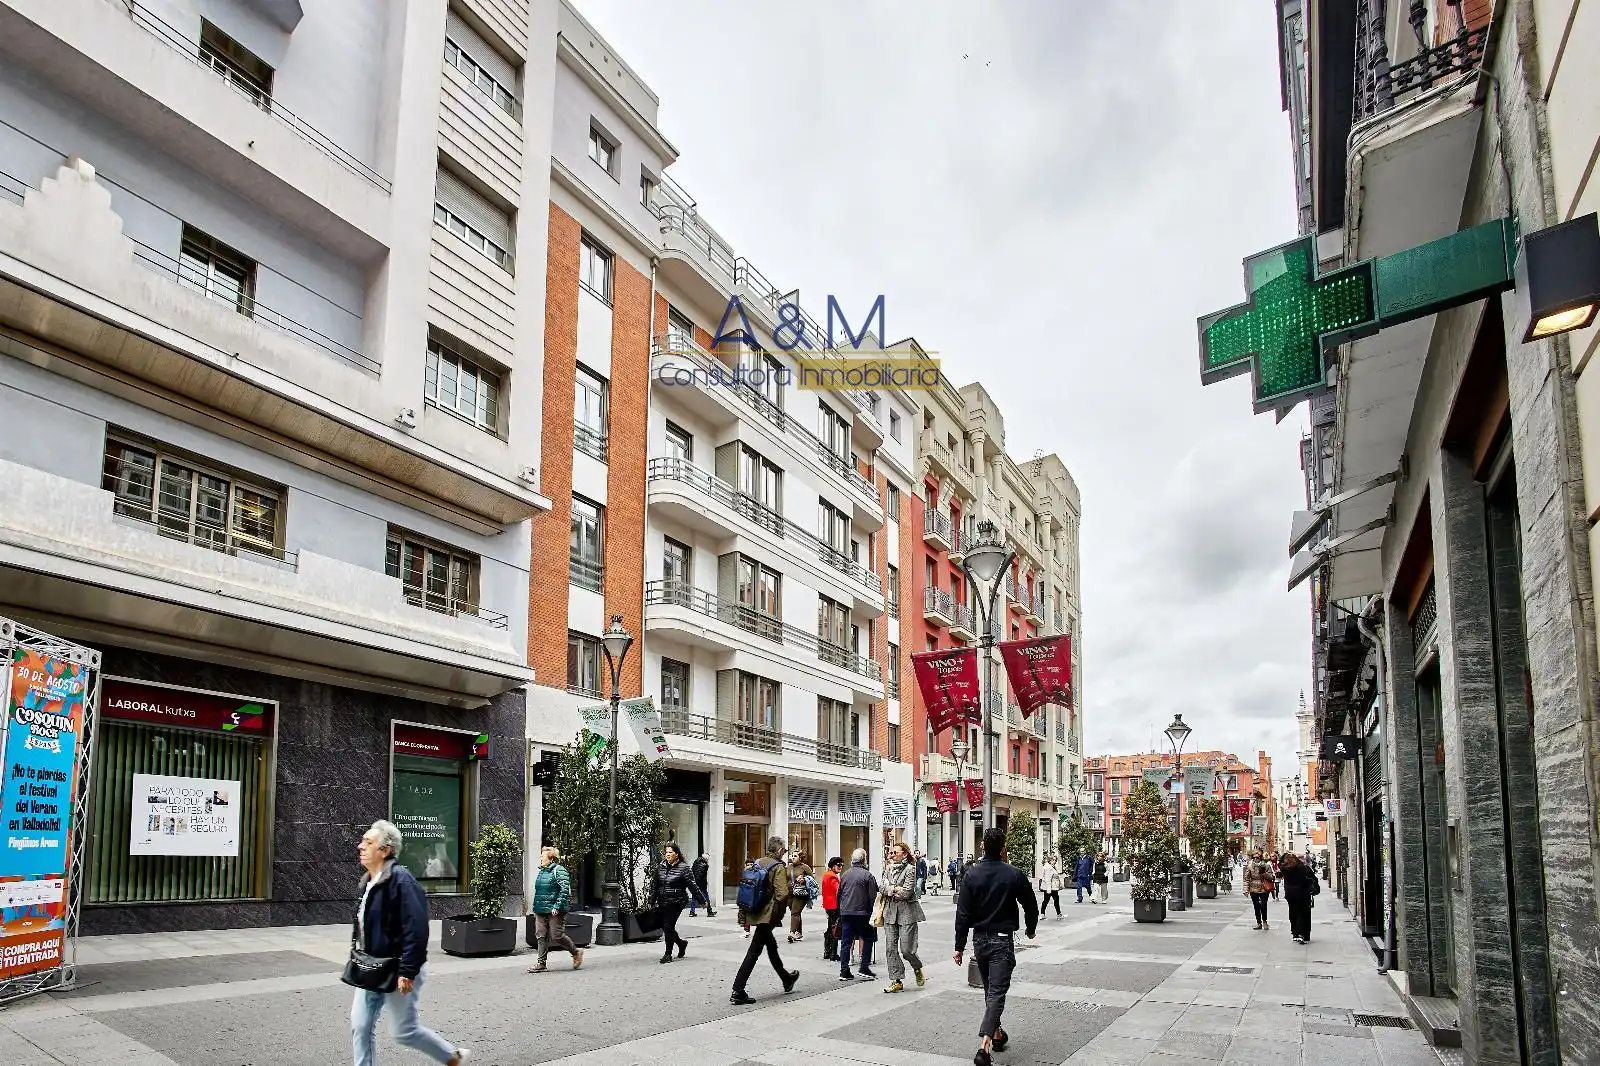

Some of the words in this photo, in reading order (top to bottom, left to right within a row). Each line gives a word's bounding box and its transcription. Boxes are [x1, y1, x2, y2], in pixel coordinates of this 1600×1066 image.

[18, 666, 29, 679] 30
[32, 671, 44, 683] DE
[46, 676, 80, 694] AGOSTO
[108, 698, 164, 714] LABORAL
[165, 705, 196, 718] kutxa
[30, 724, 59, 738] ROCK
[12, 763, 25, 780] ¡No
[27, 766, 35, 779] te
[37, 767, 66, 782] pierdas
[20, 782, 27, 796] el
[29, 783, 57, 798] festival
[150, 786, 174, 796] PARA
[16, 799, 28, 813] del
[31, 800, 58, 814] Verano
[152, 805, 202, 815] NECESITES
[791, 809, 806, 820] DAN
[807, 810, 824, 822] JOHN
[840, 812, 852, 822] DAN
[853, 813, 868, 824] JOHN
[9, 820, 19, 830] en
[4, 942, 40, 956] COMPRA
[40, 937, 60, 950] AQUÍ
[4, 956, 17, 967] TU
[17, 948, 58, 965] ENTRADA
